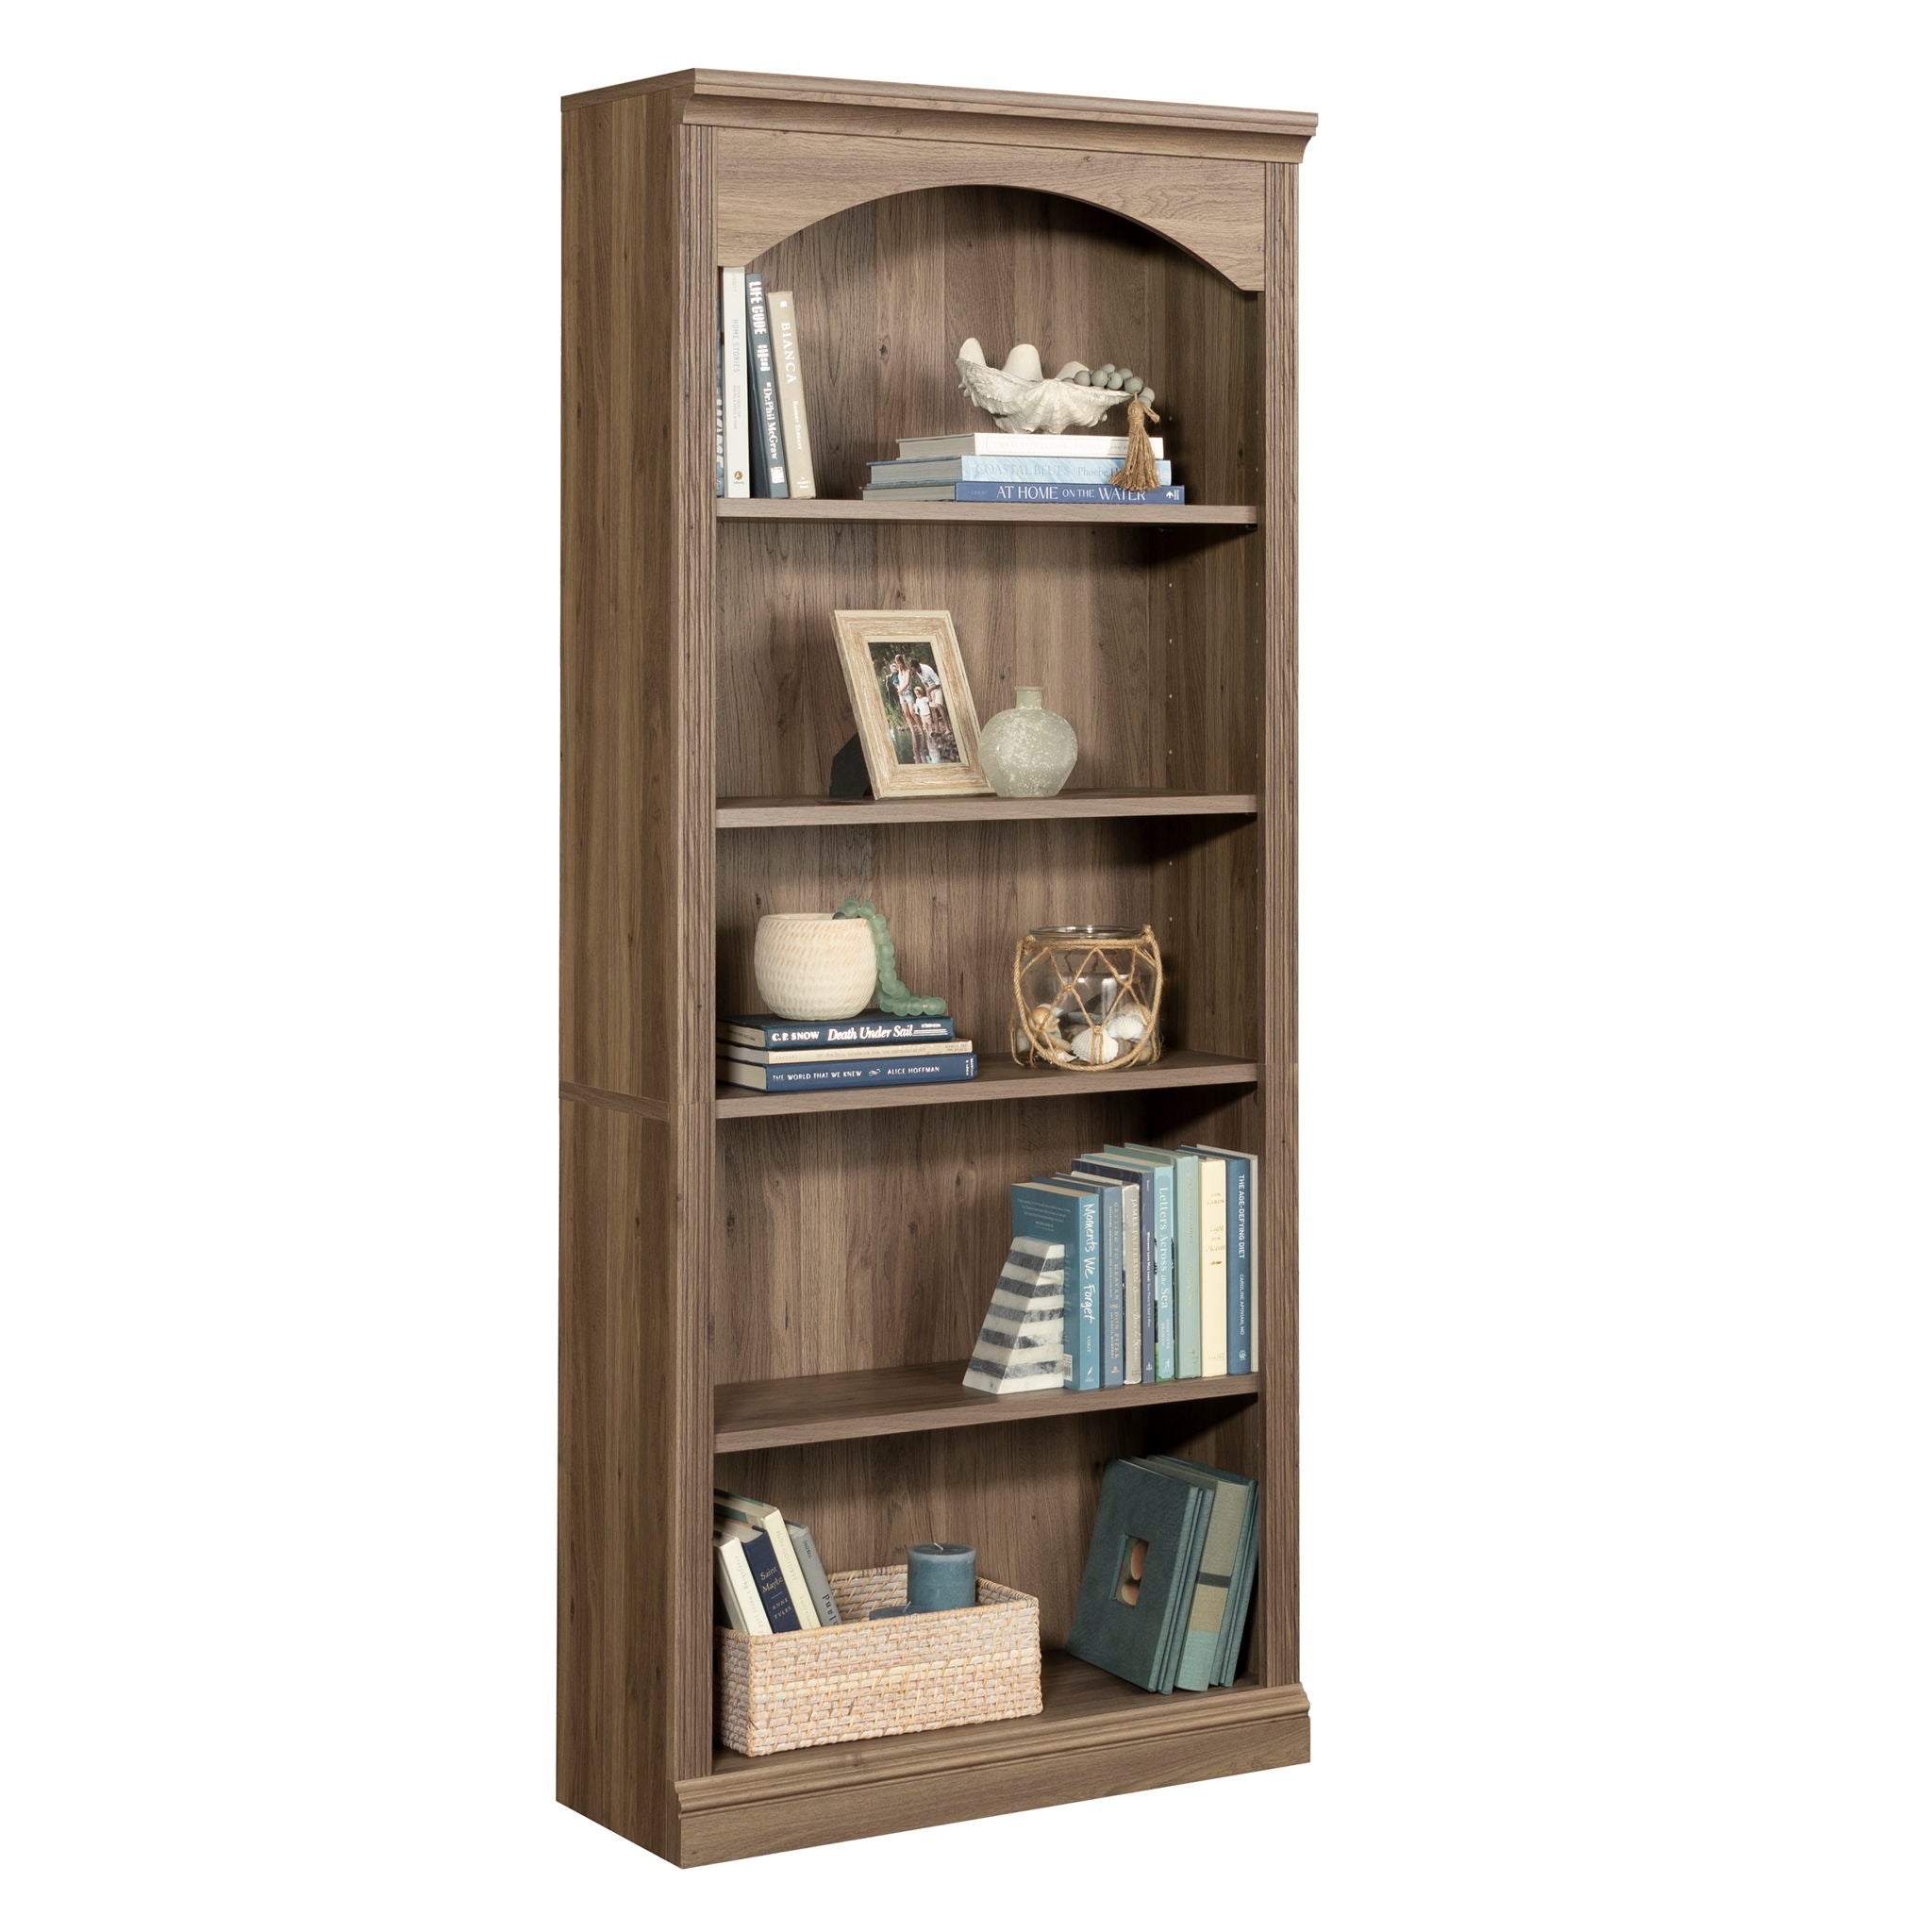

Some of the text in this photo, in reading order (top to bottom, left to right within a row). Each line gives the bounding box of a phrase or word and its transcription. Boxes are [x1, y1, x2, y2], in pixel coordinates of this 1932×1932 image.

[748, 281, 763, 305] LIFE
[781, 322, 797, 384] BIANCA
[767, 422, 778, 460] McGraw
[1077, 467, 1108, 476] Phoebe
[996, 486, 1015, 499] AT
[1018, 486, 1058, 500] HOME
[1062, 489, 1075, 497] ON
[1075, 489, 1095, 498] THE
[1098, 487, 1146, 501] WATER
[791, 1031, 820, 1041] SNOW
[827, 1024, 913, 1041] Death Under Sail
[788, 1073, 811, 1081] WORLD
[887, 1067, 906, 1075] ALICE
[1159, 1187, 1169, 1230] Letters
[1159, 1235, 1169, 1272] Across
[1080, 1203, 1098, 1324] Moments We Forget
[1160, 1287, 1170, 1309] Sea
[759, 1566, 778, 1581] Saint
[761, 1576, 784, 1593] Maybe
